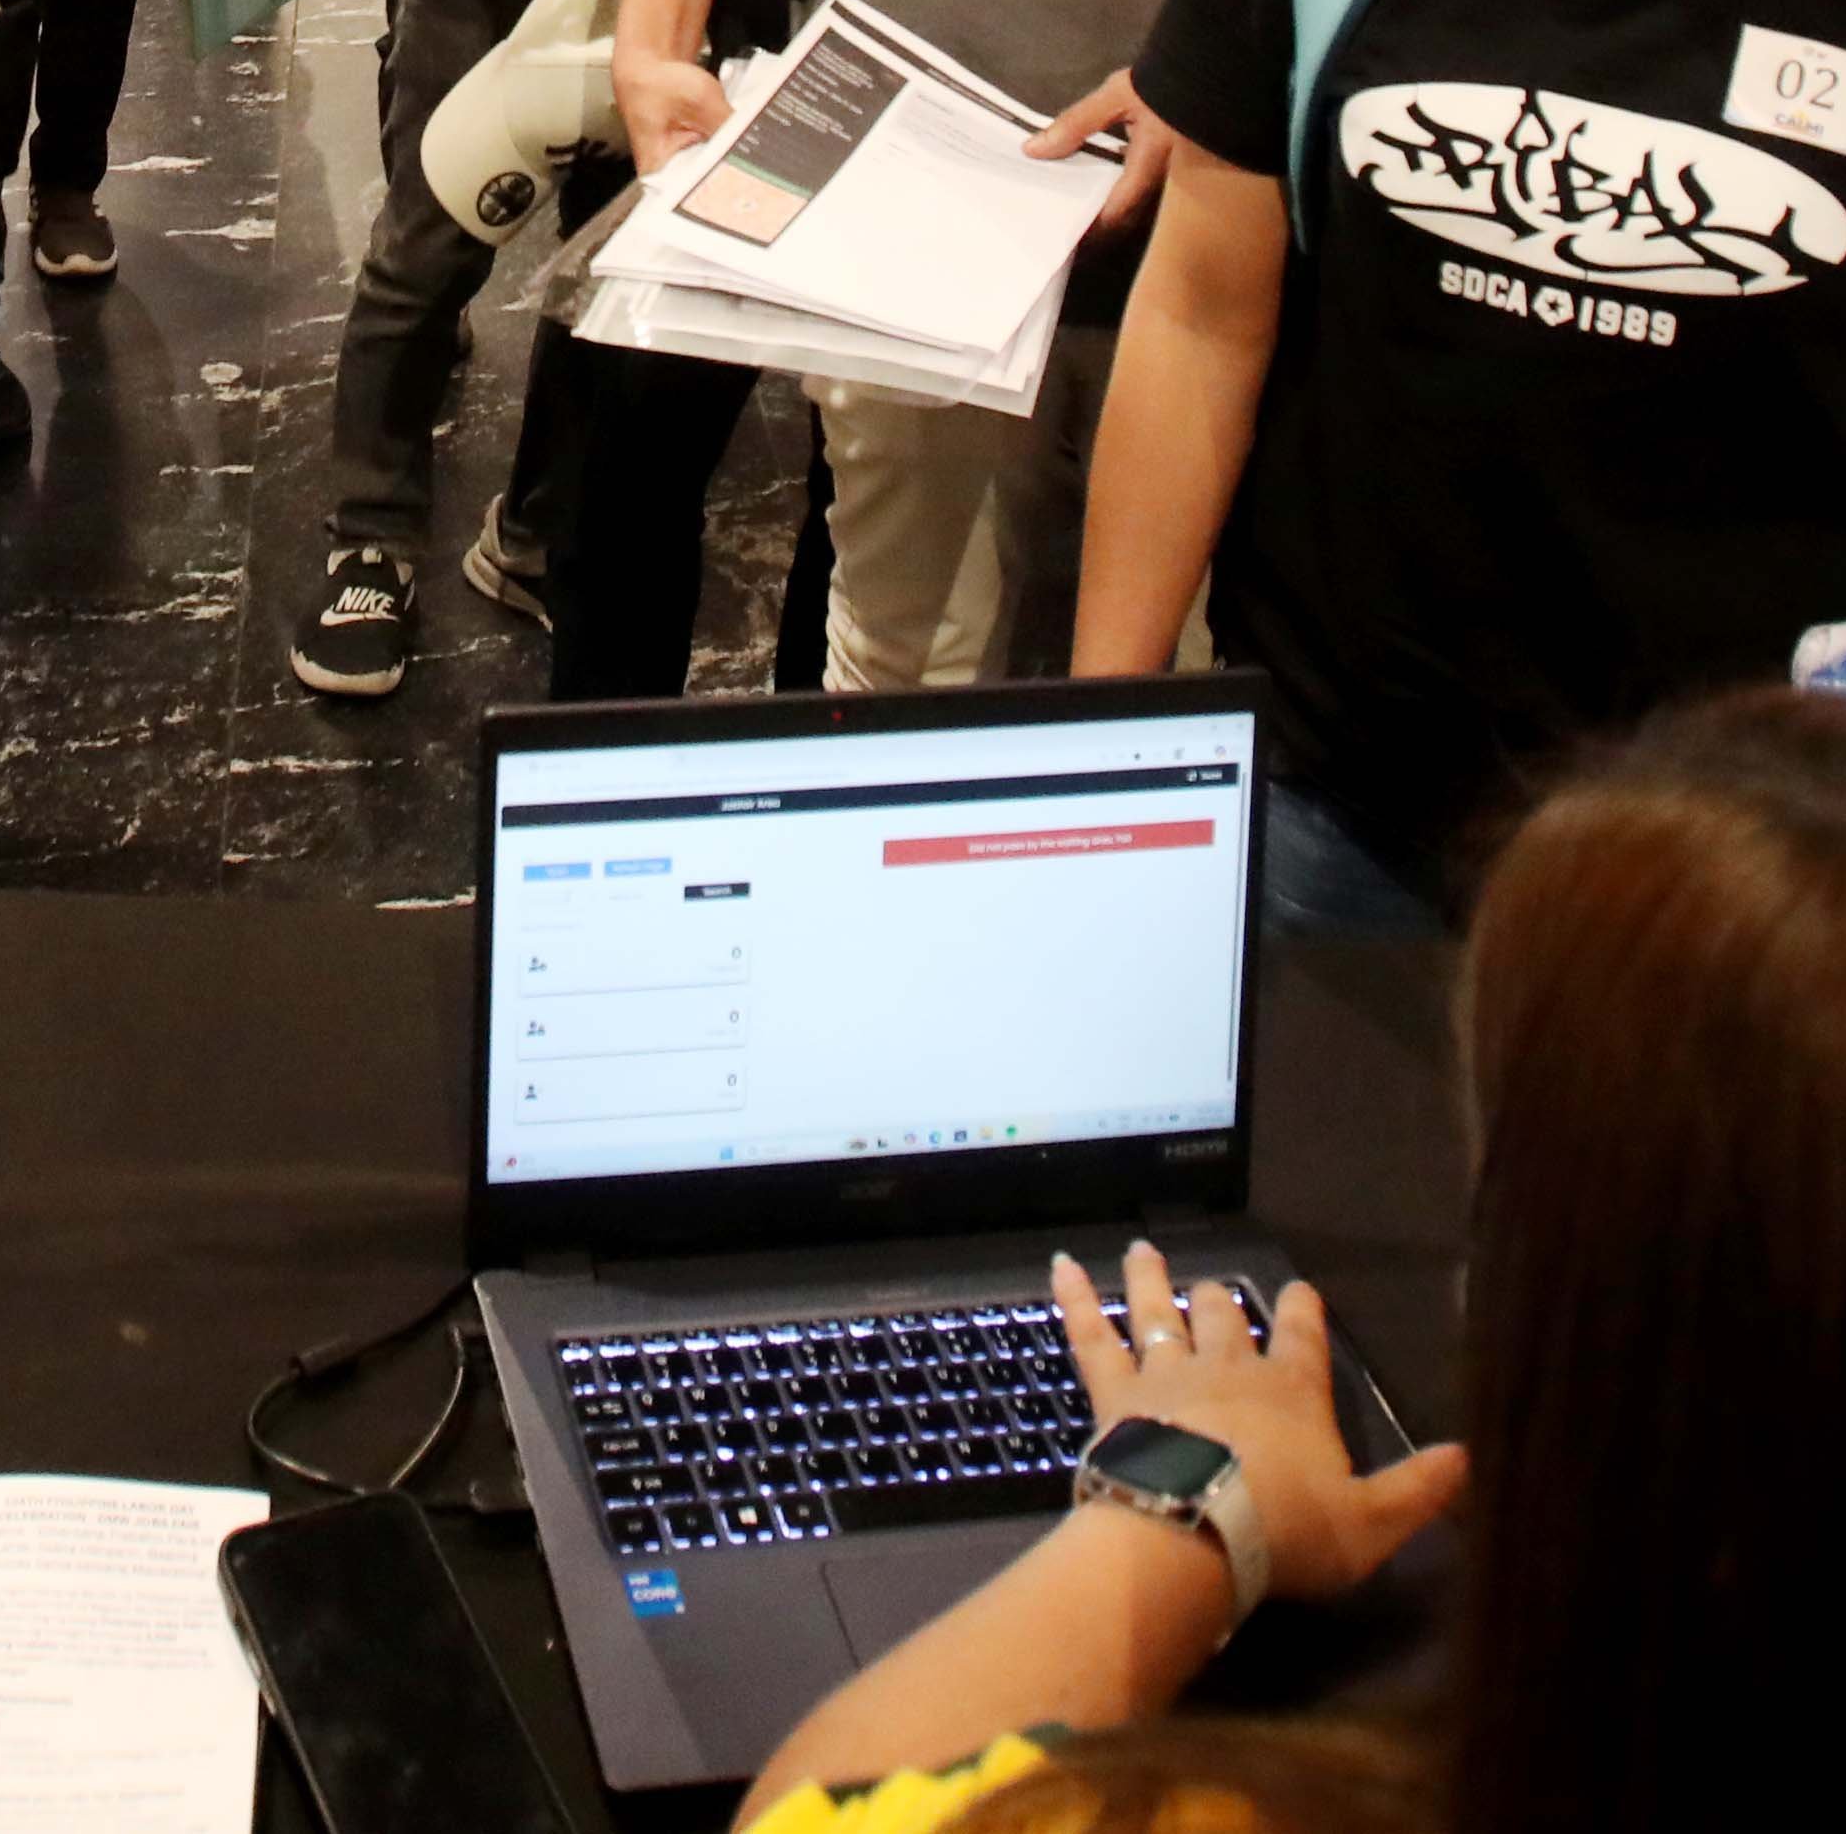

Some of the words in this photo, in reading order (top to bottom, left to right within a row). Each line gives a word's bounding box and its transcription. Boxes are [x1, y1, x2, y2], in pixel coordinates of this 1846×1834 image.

[1775, 59, 1839, 111] 02
[1439, 260, 1528, 318] SDCA
[1578, 295, 1678, 347] 1989
